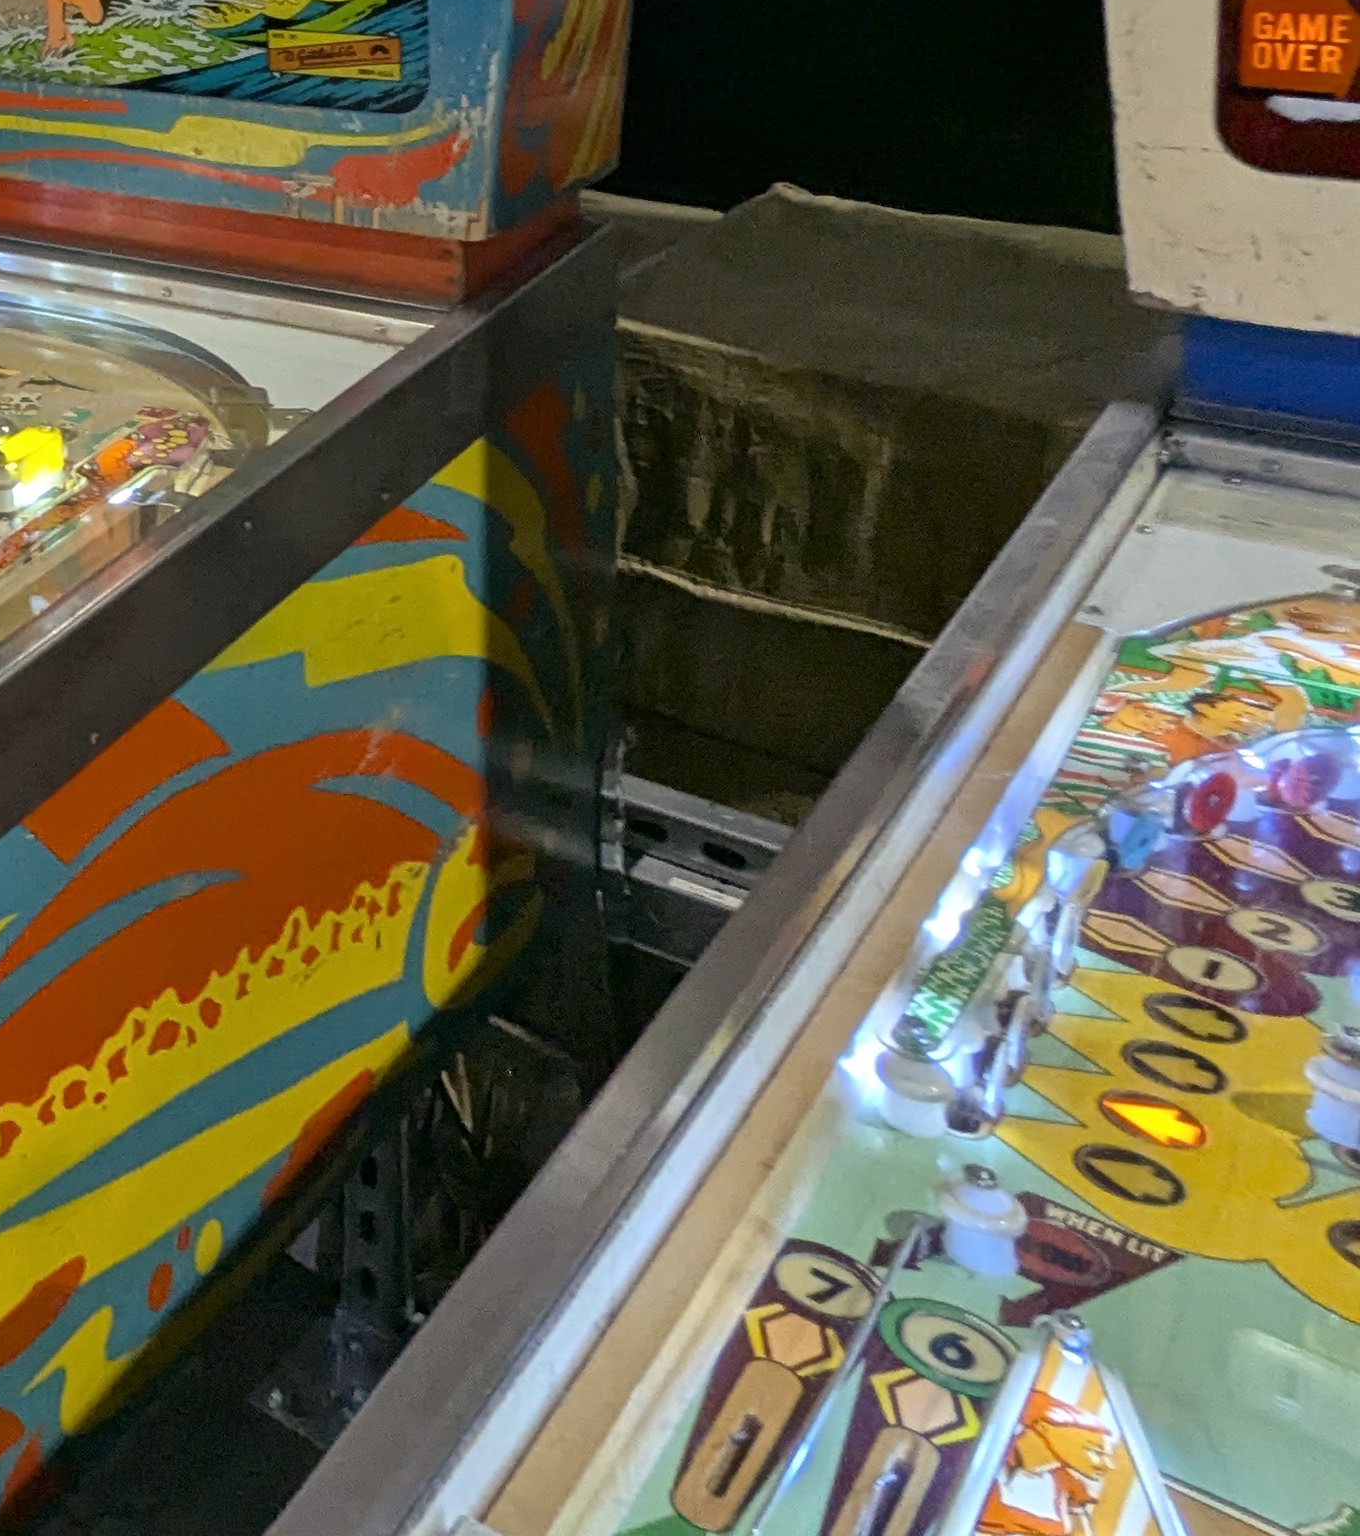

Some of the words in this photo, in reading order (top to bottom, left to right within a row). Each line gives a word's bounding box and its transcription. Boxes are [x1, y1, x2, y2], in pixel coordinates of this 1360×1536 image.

[1252, 11, 1354, 44] GAME
[1252, 41, 1343, 74] OVER
[1249, 915, 1293, 946] 2
[1043, 1203, 1124, 1248] WHEN
[1126, 1236, 1168, 1263] LIT
[807, 1267, 852, 1305] 7
[927, 1330, 979, 1370] 6
